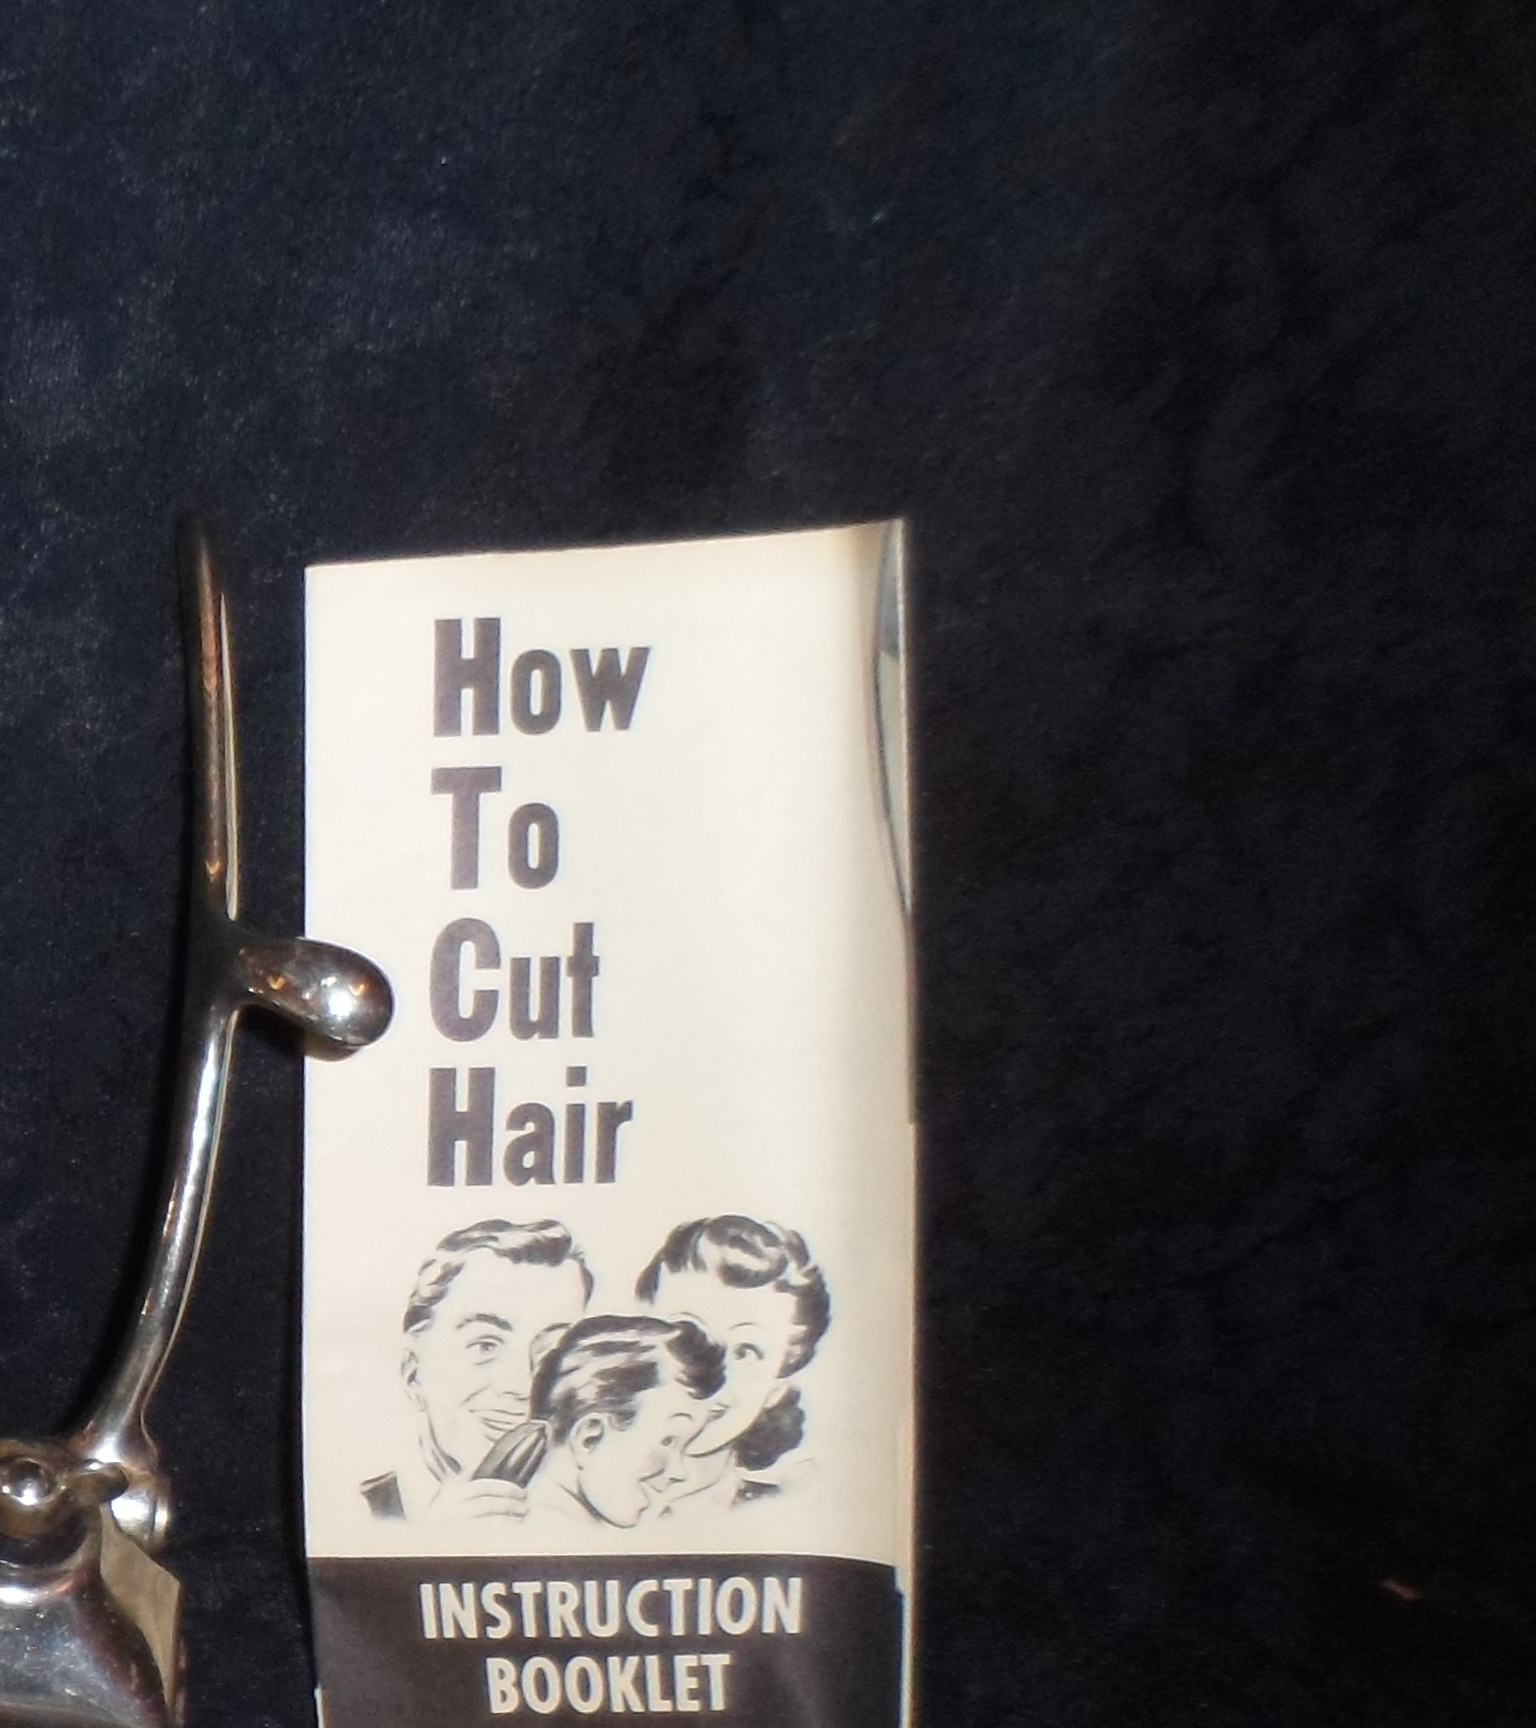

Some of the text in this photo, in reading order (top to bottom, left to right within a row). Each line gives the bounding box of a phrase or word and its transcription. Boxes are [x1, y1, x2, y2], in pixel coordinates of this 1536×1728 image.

[433, 617, 651, 738] How
[430, 765, 560, 890] To
[428, 917, 600, 1042] Cut
[427, 1065, 633, 1188] Hair
[419, 1575, 804, 1640] INSTRUCTION
[485, 1653, 731, 1714] BOOKLET
